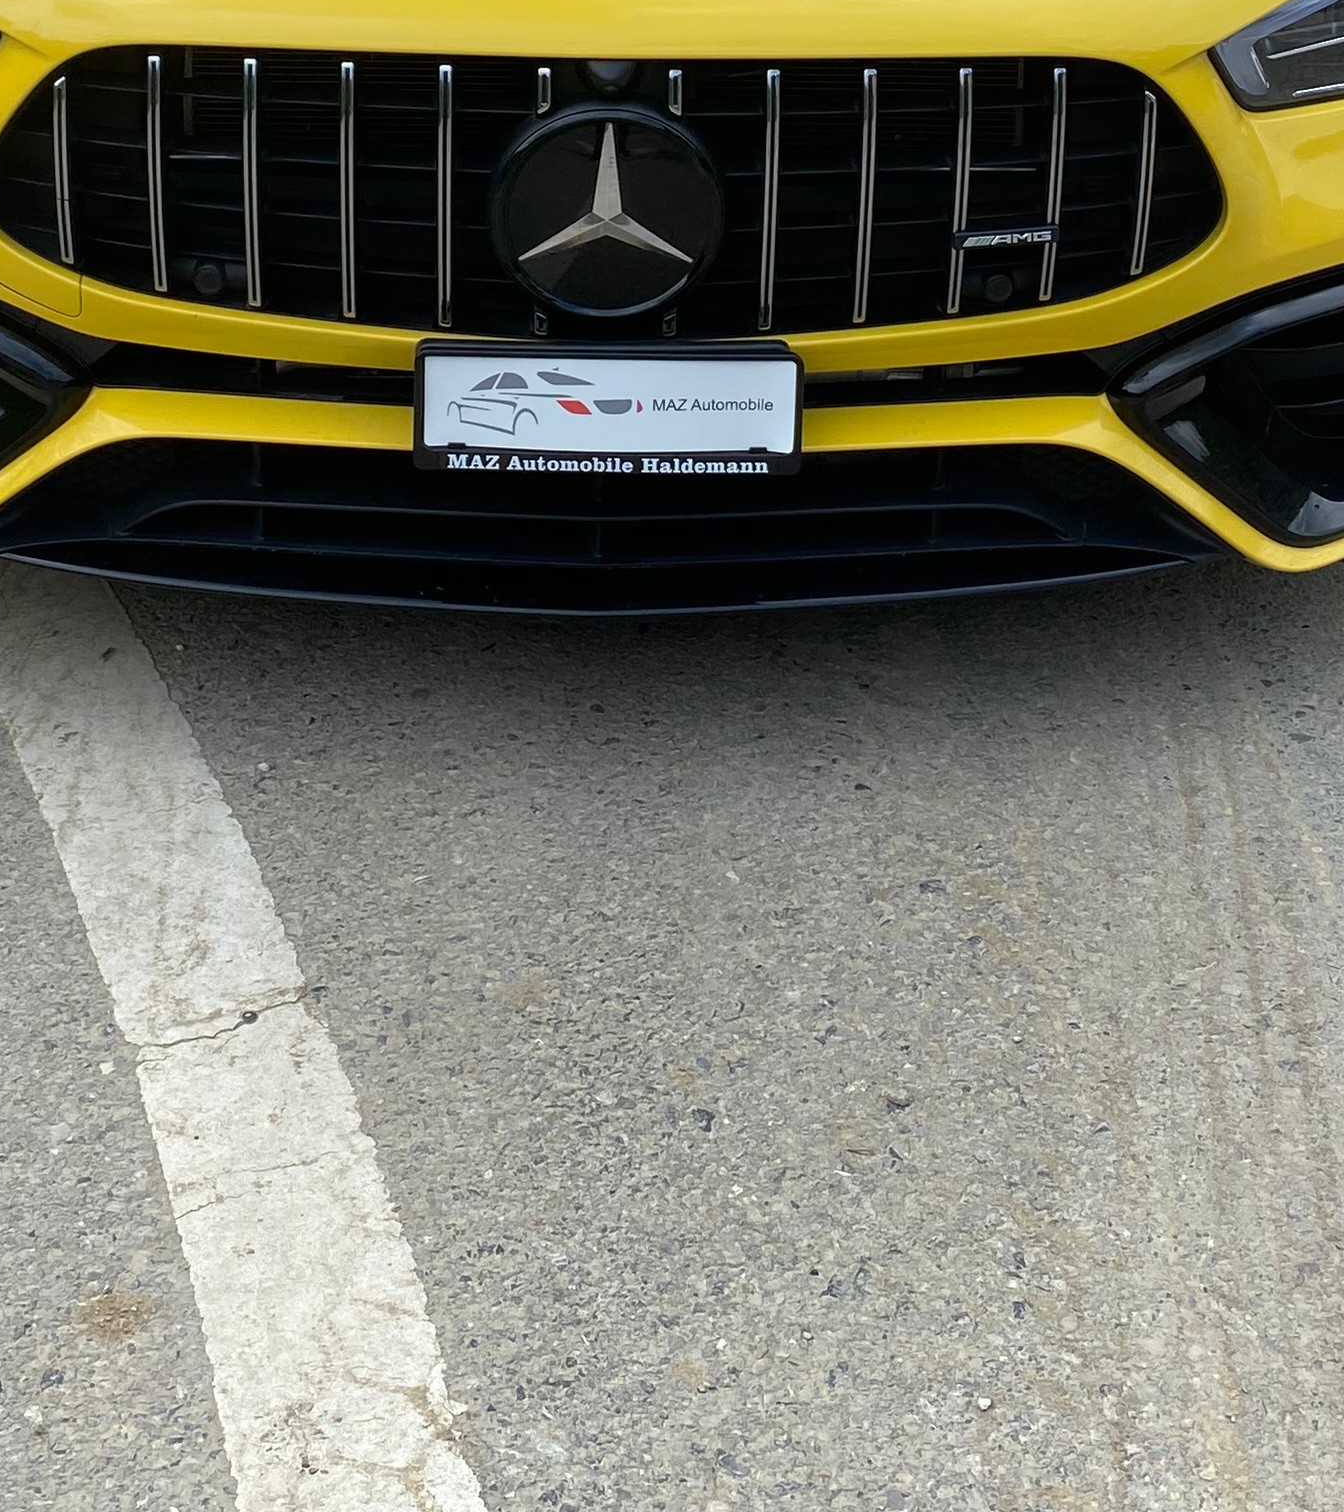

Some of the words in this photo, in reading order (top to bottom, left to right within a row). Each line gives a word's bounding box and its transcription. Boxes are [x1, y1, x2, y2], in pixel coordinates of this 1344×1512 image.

[990, 230, 1052, 246] AMG
[652, 398, 687, 412] MAZ
[690, 397, 774, 413] Automobile
[447, 453, 501, 471] MAZ
[506, 455, 633, 474] Automobile
[640, 458, 769, 475] Haldemann
